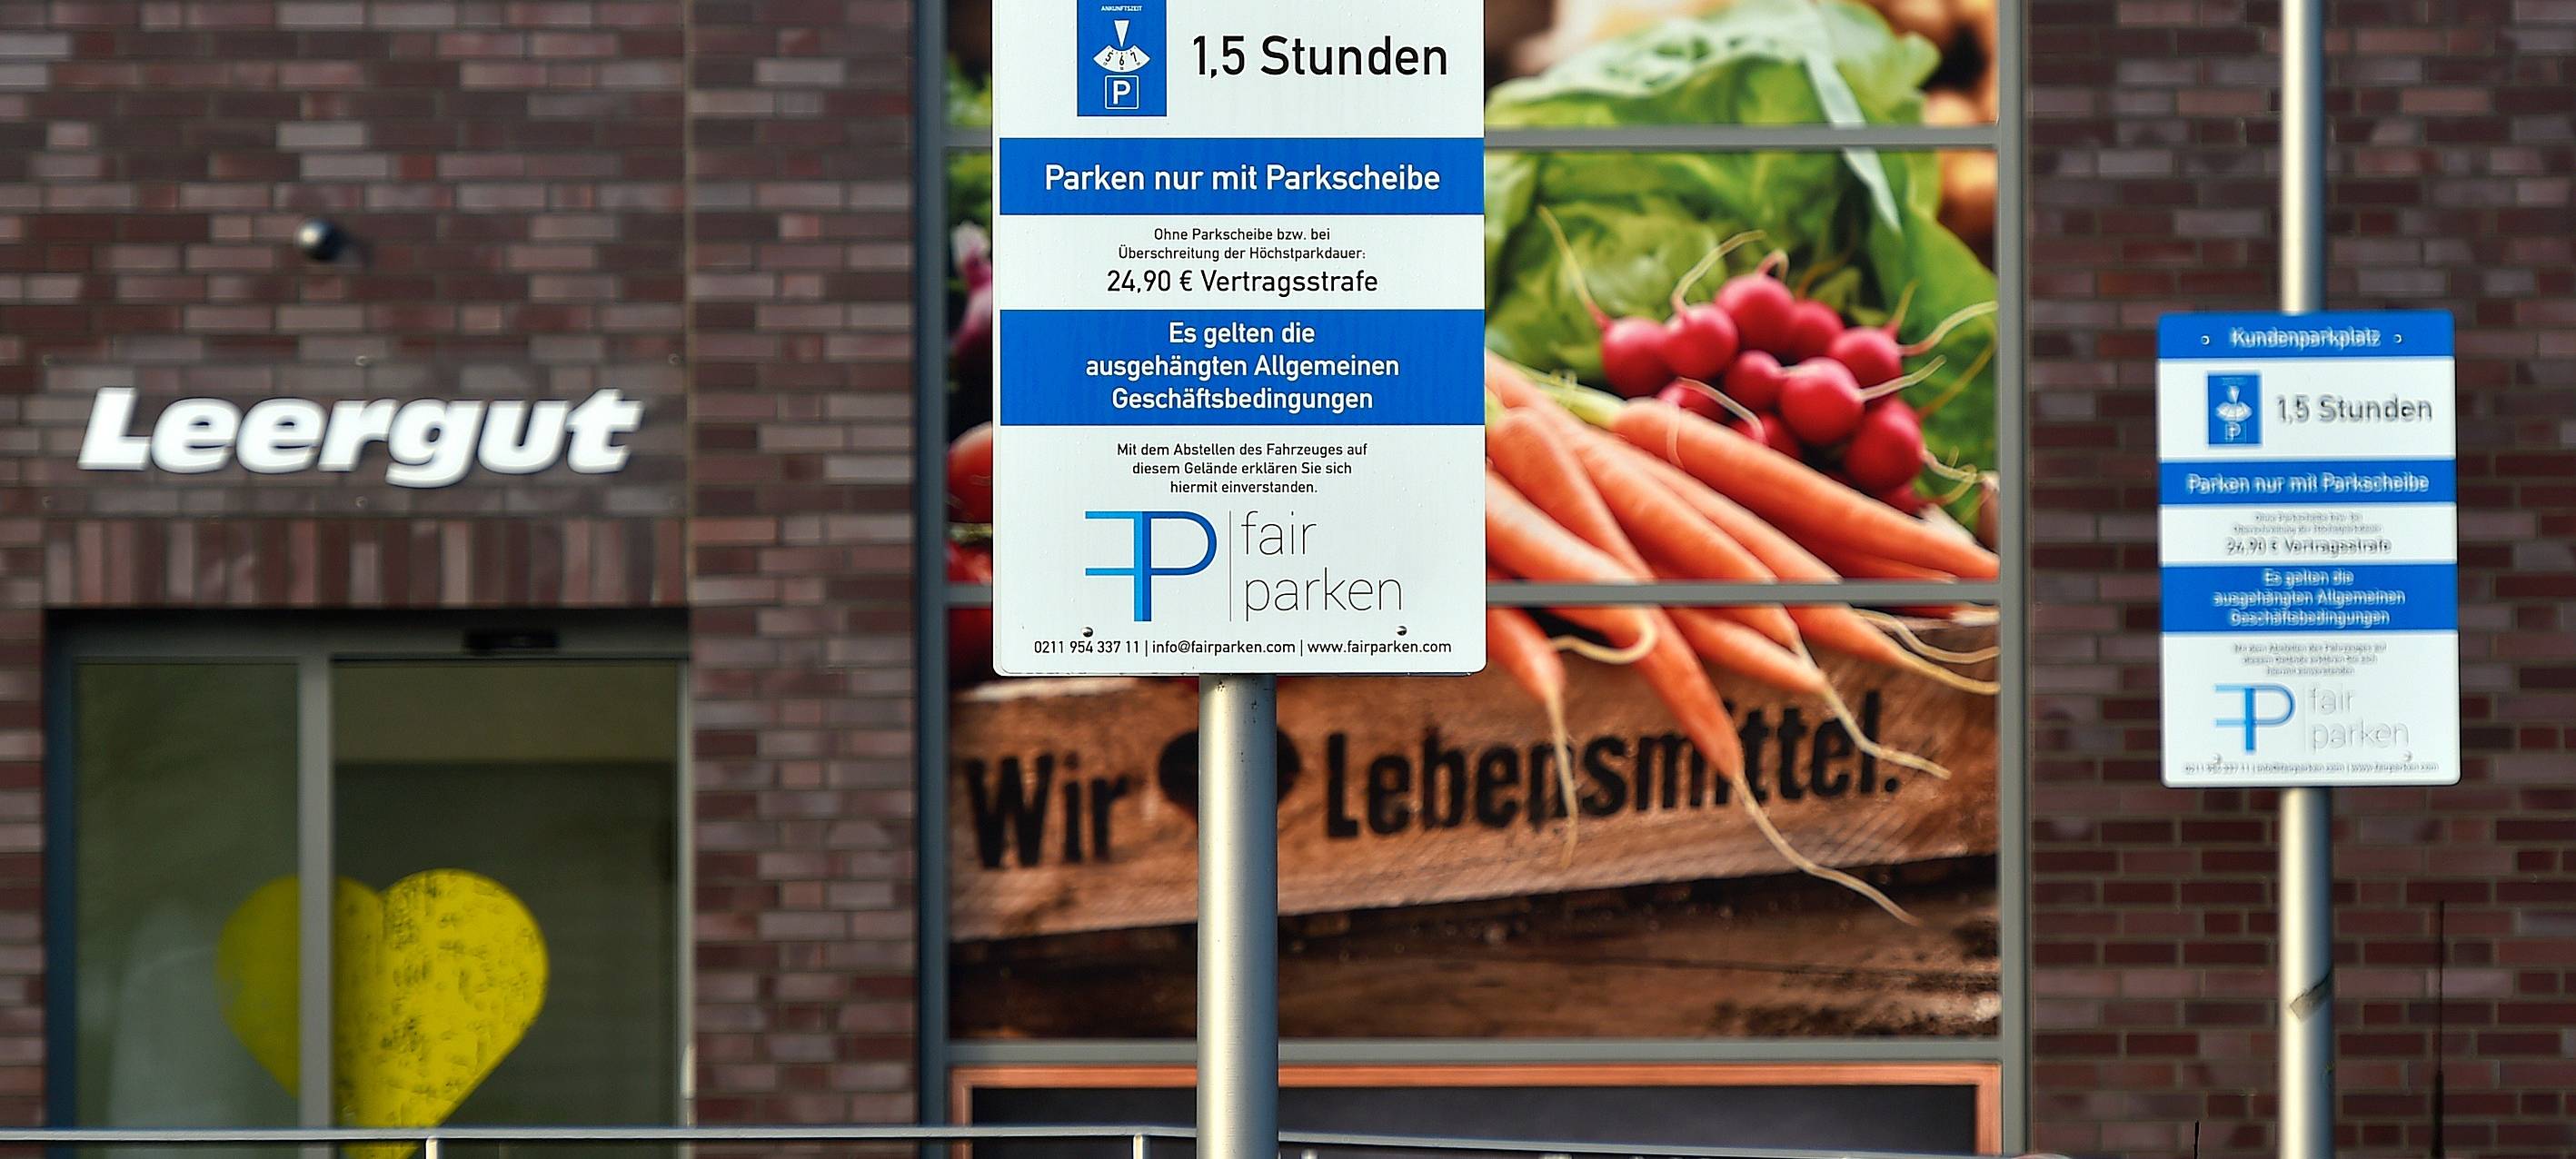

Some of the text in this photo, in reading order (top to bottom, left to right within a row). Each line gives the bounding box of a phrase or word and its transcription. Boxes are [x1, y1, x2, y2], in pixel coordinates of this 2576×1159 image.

[1119, 54, 1125, 66] 6
[1193, 35, 1447, 79] 1,5 Stunden
[1112, 79, 1132, 105] P
[1045, 163, 1440, 191] Parken nur mit Parkscheibe
[1154, 227, 1330, 241] Ohne Parkscheibe bzw. bei
[1119, 243, 1367, 262] Überschreitung der Höchstparkdauer:
[1107, 269, 1379, 298] 24,90 € Vertragsstrafe
[1169, 321, 1316, 349] Es gelten die
[2230, 326, 2382, 350] Kundenparkplatz
[1086, 353, 1400, 378] ausgehängten Allgemeinen
[1112, 387, 1374, 414] Geschäftsbedingungen
[2276, 393, 2433, 425] 1,5 Stunden
[77, 386, 644, 489] Leergut
[1117, 442, 1368, 459] Mit dem Abstellen des Fahrzeuges auf
[1132, 461, 1352, 475] diesem Gelände erklären Sie sich
[1170, 480, 1318, 493] hiermit einverstanden.
[2186, 472, 2430, 493] Parken nur mit Parkscheibe
[1240, 510, 1318, 556] fair
[1245, 566, 1402, 623] parken
[1034, 639, 1065, 655] 0211
[1069, 639, 1094, 655] 954
[1097, 639, 1121, 655] 337
[1125, 639, 1139, 655] 11
[1152, 639, 1296, 657] info@fairparken.com
[1307, 639, 1452, 657] www.fairparken.com
[2309, 684, 2356, 714] fair
[2312, 718, 2411, 754] parken
[965, 749, 1132, 870] Wir
